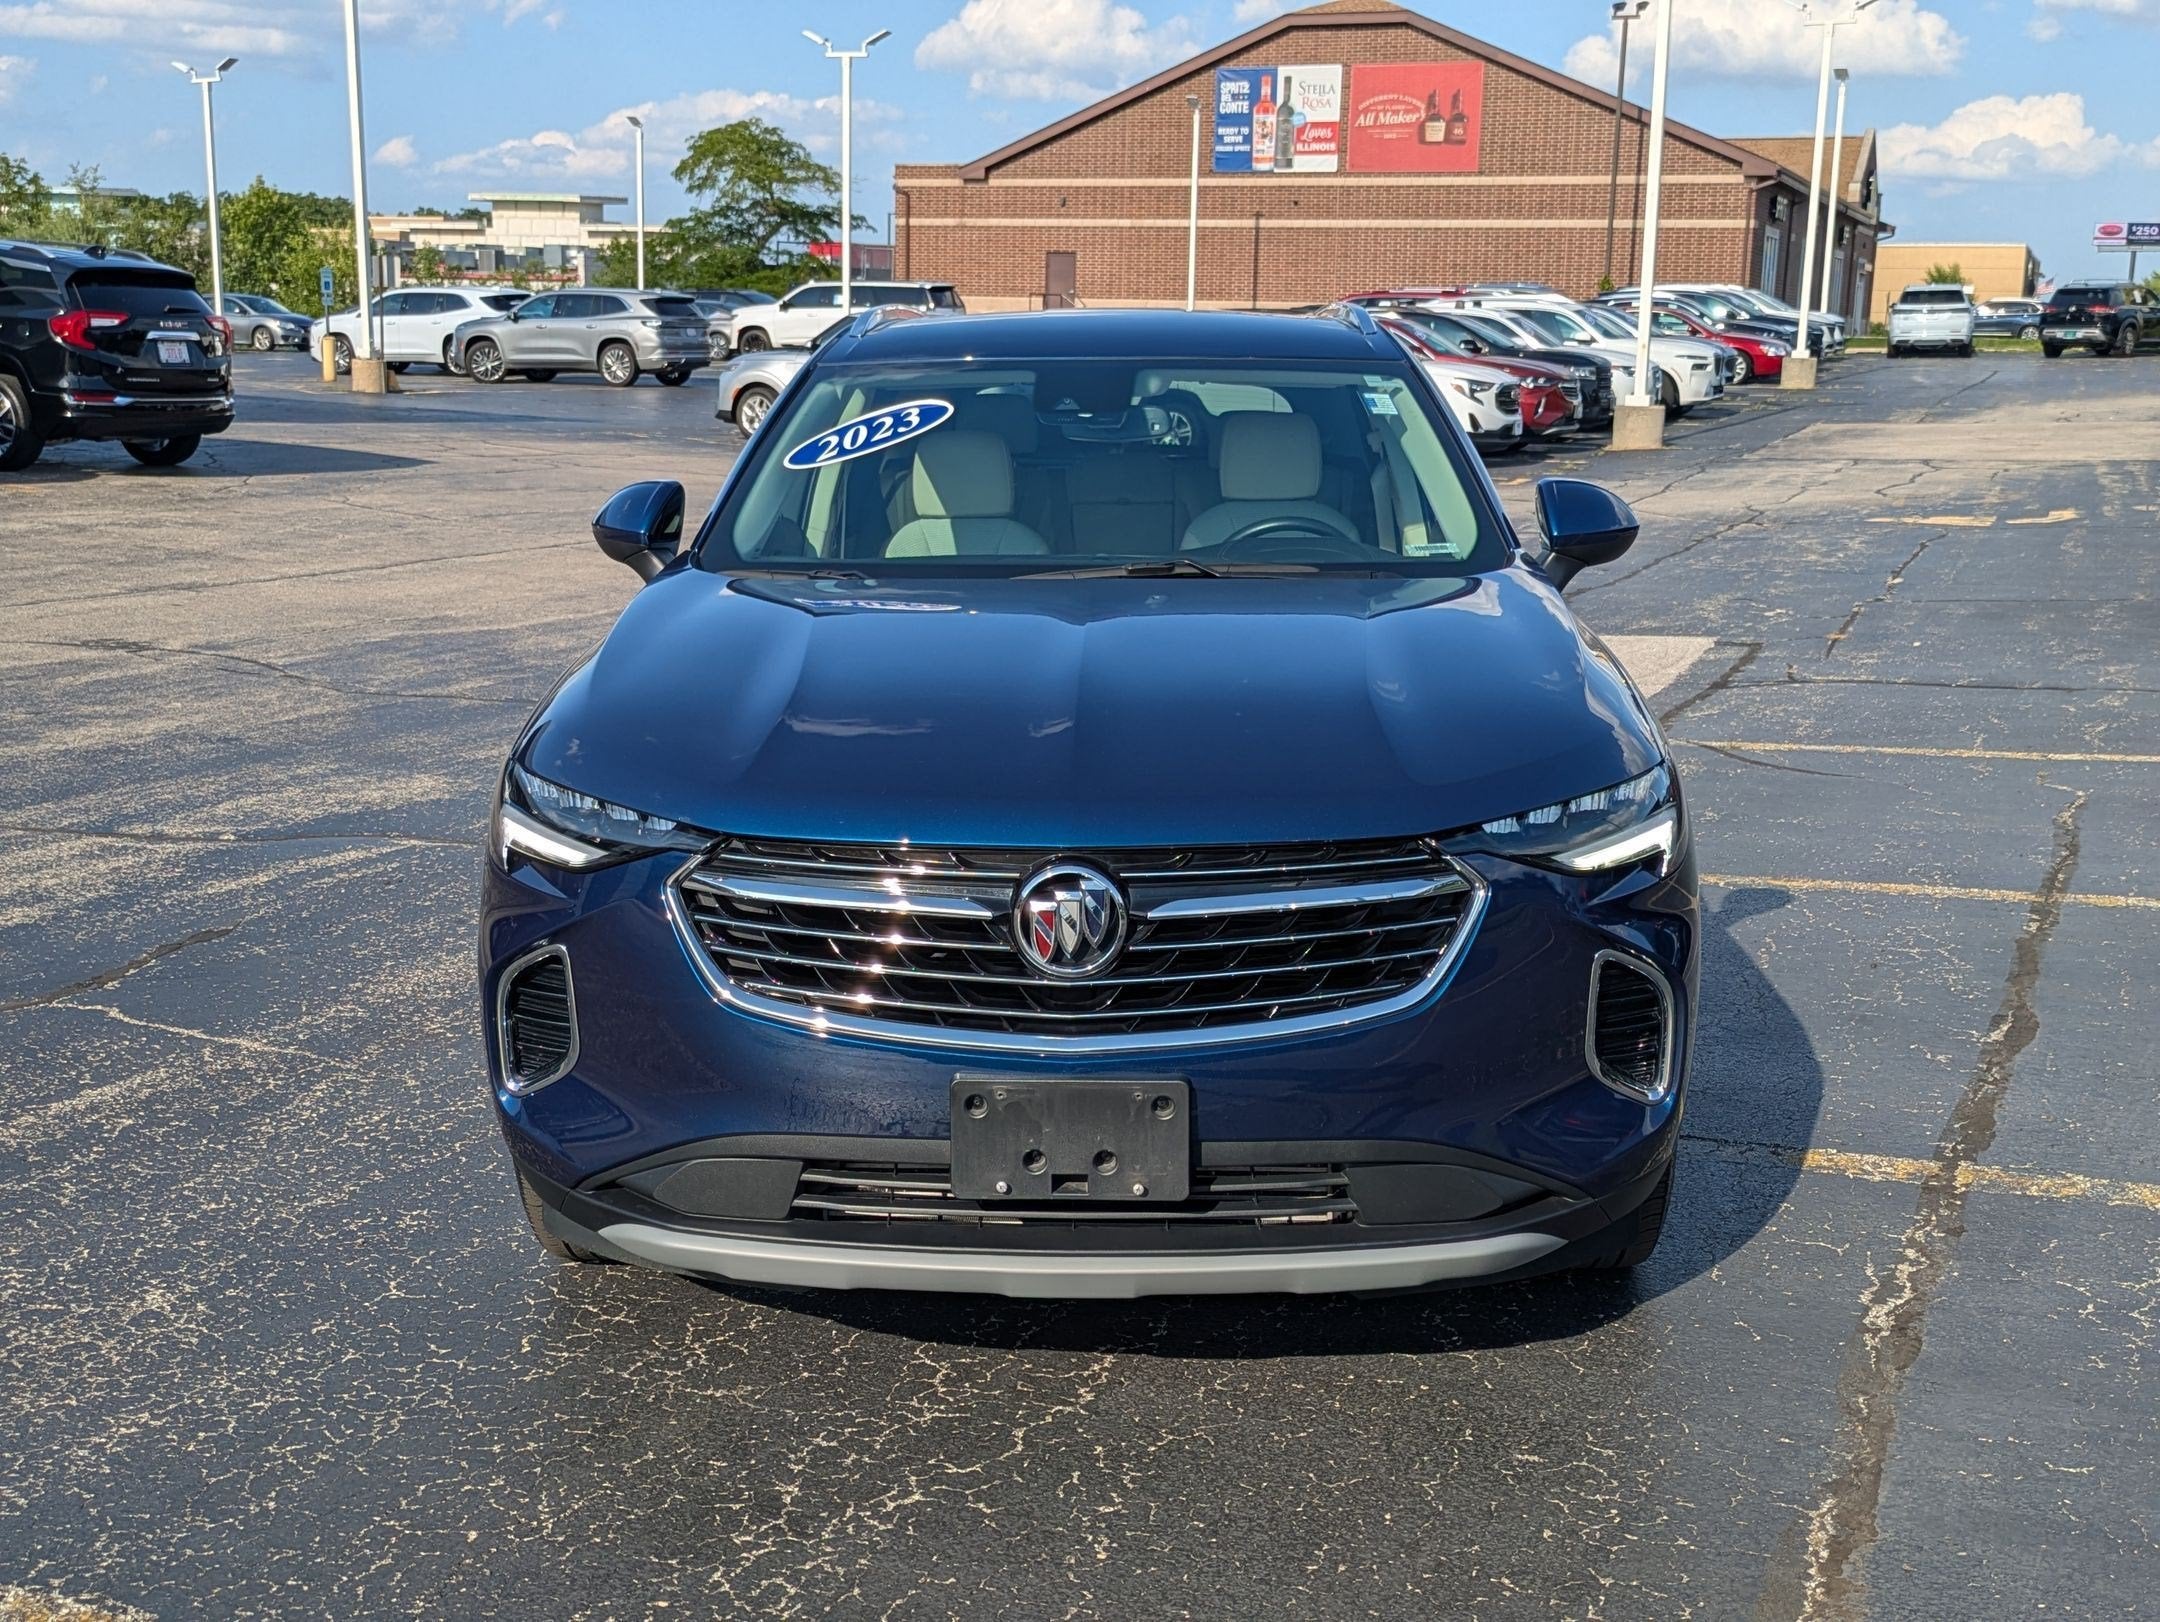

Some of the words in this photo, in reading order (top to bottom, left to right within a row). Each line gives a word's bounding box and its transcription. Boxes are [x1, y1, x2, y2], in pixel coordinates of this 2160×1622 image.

[1220, 82, 1250, 94] SPRITZ
[1298, 81, 1335, 96] STELLA
[1220, 101, 1249, 114] CONTE
[1302, 97, 1332, 111] ROSA
[1354, 112, 1377, 128] All
[1217, 127, 1239, 135] READY
[1240, 127, 1249, 135] TO
[1300, 123, 1333, 142] Loves
[1453, 128, 1464, 136] 46
[1223, 136, 1243, 144] SERVE
[1296, 142, 1337, 152] ILLINOIS
[2131, 225, 2159, 236] $250
[816, 407, 921, 463] 2023
